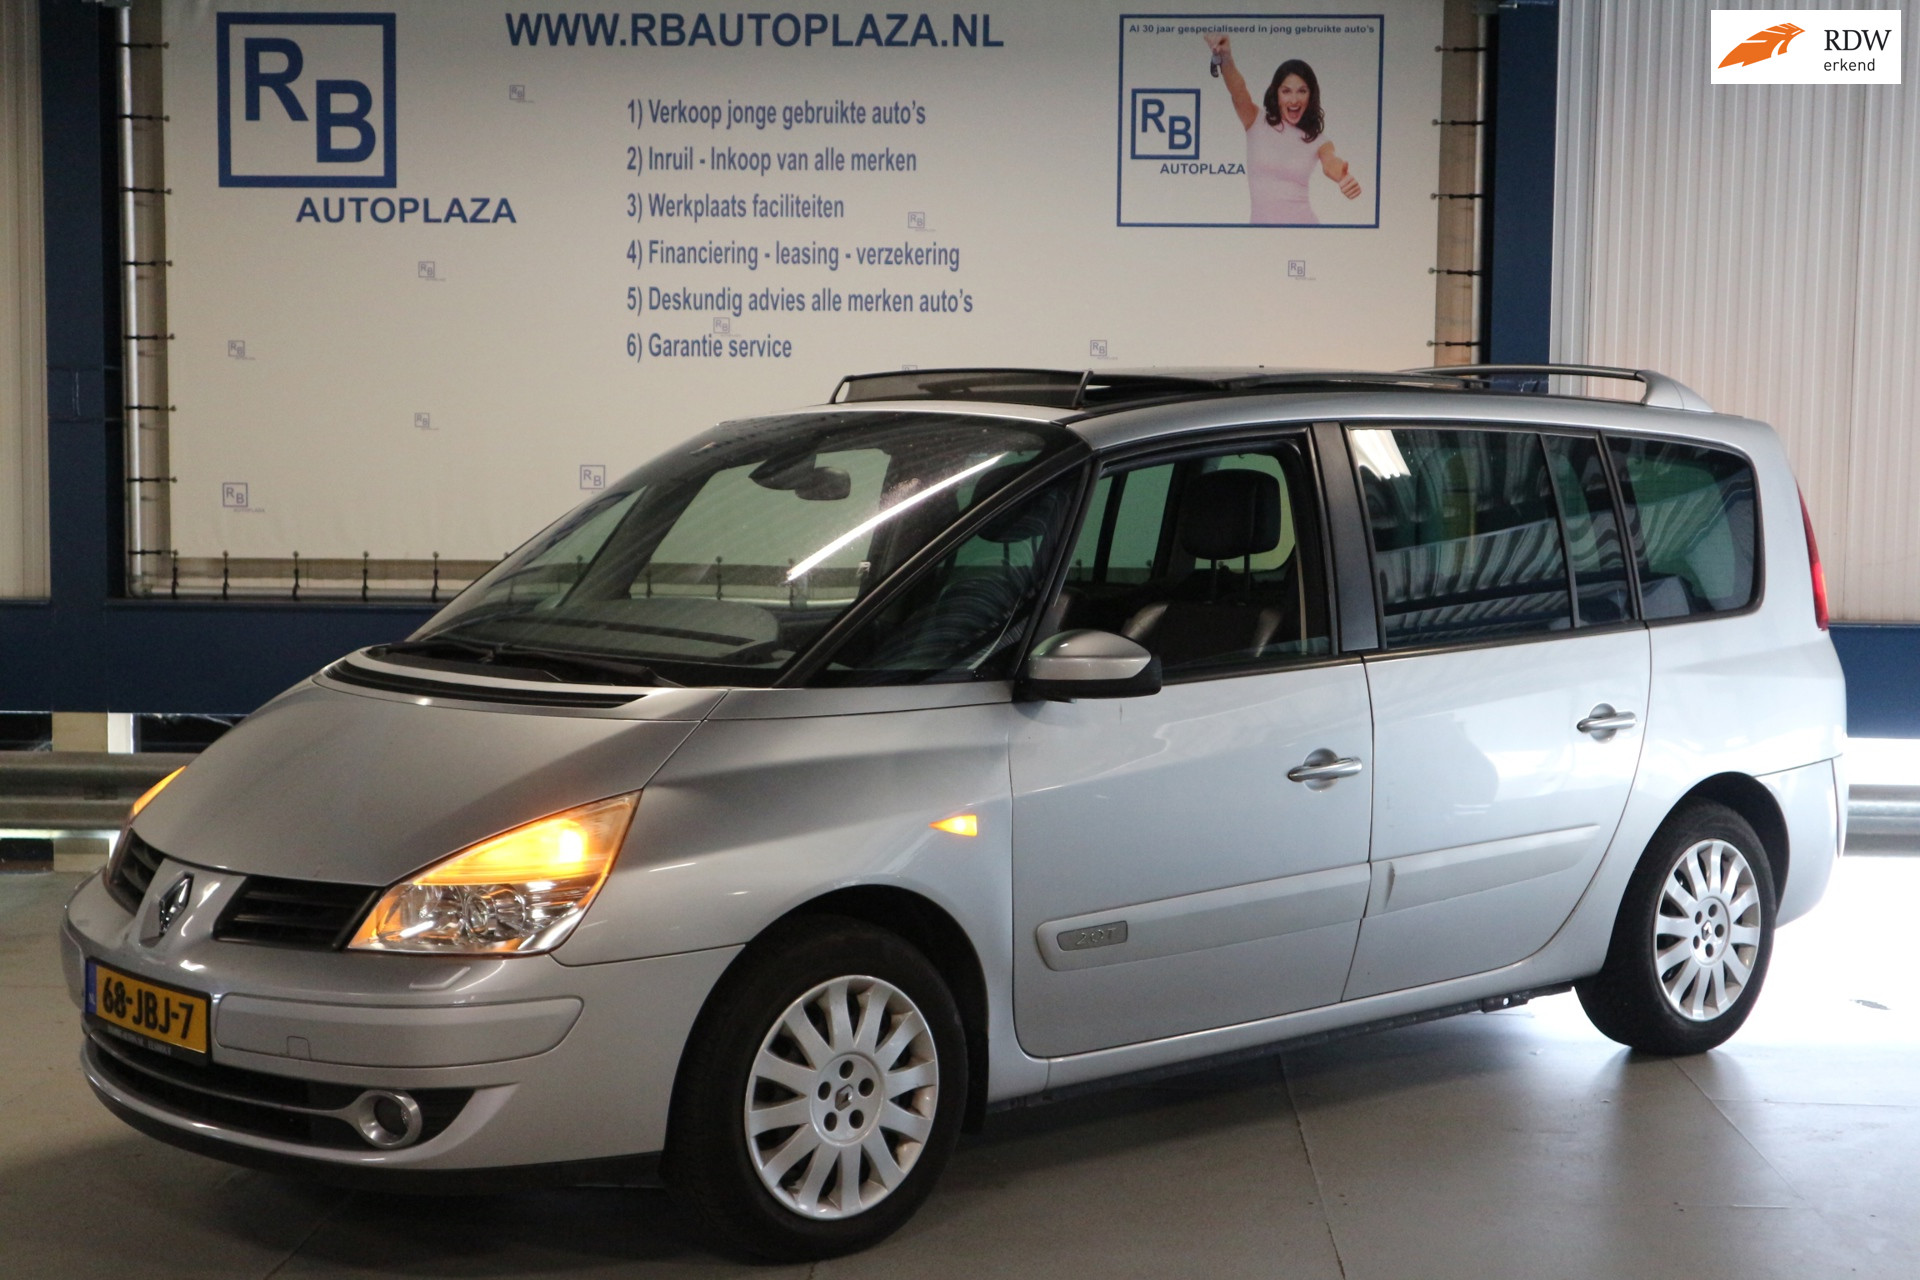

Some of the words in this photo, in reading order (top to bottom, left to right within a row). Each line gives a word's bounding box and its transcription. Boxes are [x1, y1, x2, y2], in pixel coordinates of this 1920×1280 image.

[506, 13, 1004, 47] WWW.RBAUTOPLAZA.NL
[1143, 25, 1154, 33] 30
[1156, 25, 1175, 35] jaar
[1178, 24, 1255, 35] gespecialiseerd
[1258, 25, 1267, 33] in
[1270, 25, 1292, 35] jong
[1295, 25, 1342, 35] gebruikte
[1344, 25, 1375, 34] auto's
[244, 37, 376, 163] RB
[628, 99, 643, 130] 1)
[649, 99, 722, 130] Verkoop
[726, 100, 777, 130] jonge
[782, 100, 866, 131] gebruikte
[872, 100, 926, 125] auto's
[1141, 98, 1192, 150] RB
[627, 146, 643, 176] 2)
[649, 146, 693, 171] Inruil
[711, 146, 771, 177] Inkoop
[776, 151, 808, 171] van
[814, 147, 845, 171] alle
[851, 147, 917, 172] merken
[1160, 163, 1246, 175] AUTOPLAZA
[296, 197, 517, 224] AUTOPLAZA
[627, 193, 643, 223] 3)
[649, 193, 747, 223] Werkplaats
[752, 193, 844, 218] faciliteiten
[626, 239, 643, 270] 4)
[649, 239, 758, 271] Financiering
[776, 240, 839, 271] leasing
[856, 241, 960, 272] verzekering
[627, 286, 643, 316] 5)
[649, 286, 743, 317] Deskundig
[748, 287, 806, 311] advies
[811, 288, 842, 312] alle
[847, 288, 914, 312] merken
[919, 289, 973, 313] auto's
[627, 333, 643, 363] 6)
[648, 333, 723, 357] Garantie
[728, 334, 793, 357] service
[225, 487, 245, 505] RB
[102, 977, 195, 1041] 68-JBJ-7
